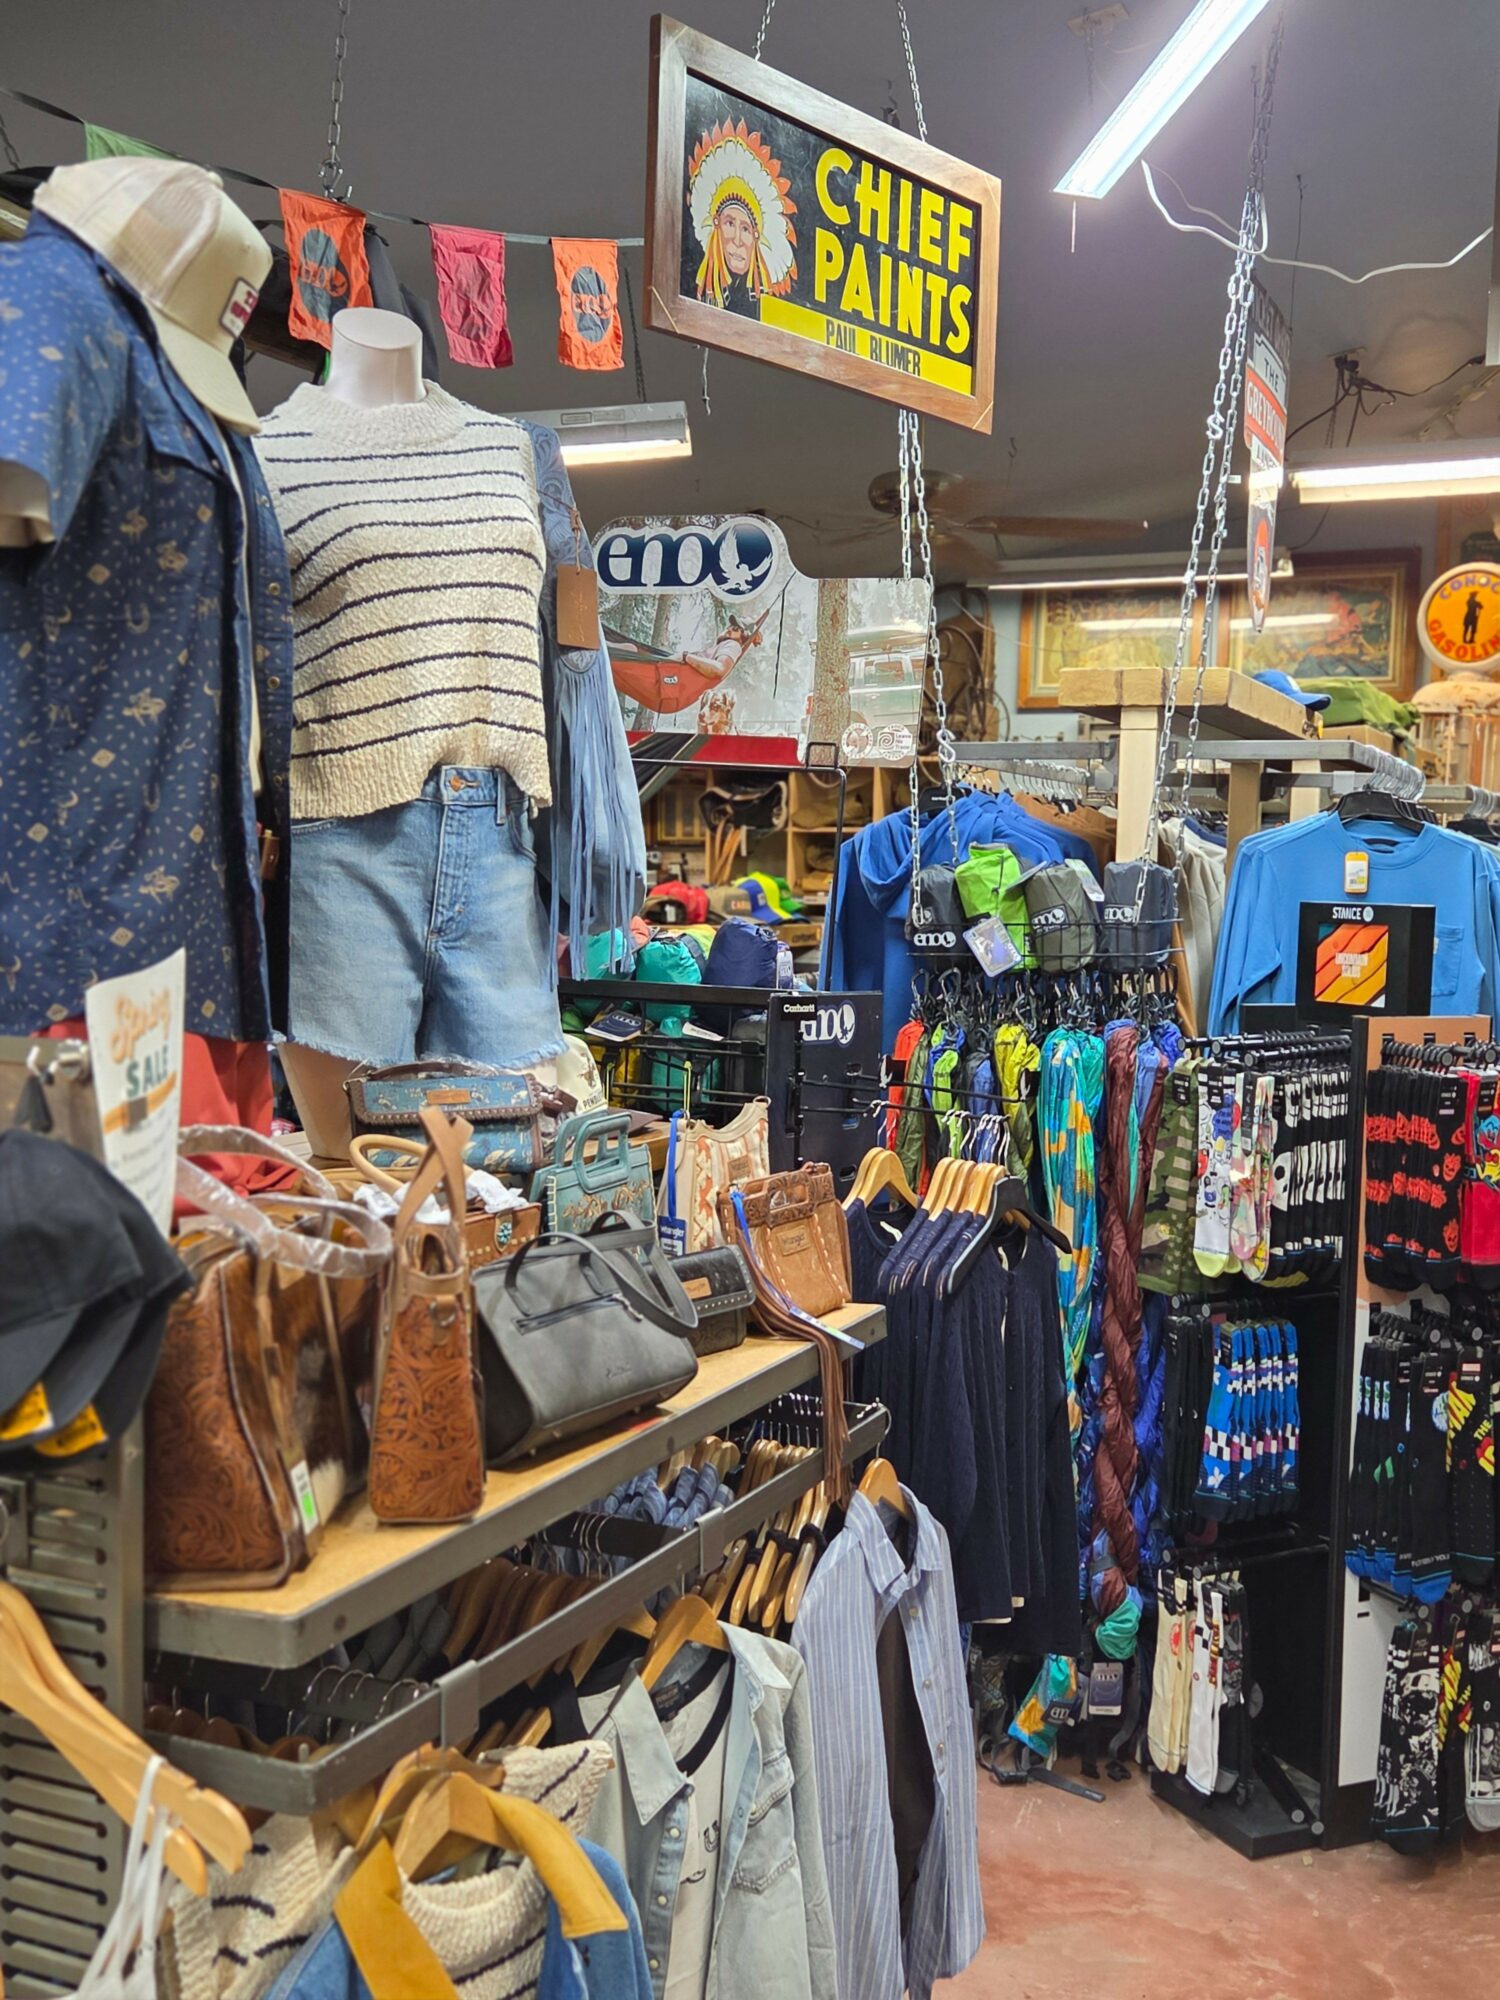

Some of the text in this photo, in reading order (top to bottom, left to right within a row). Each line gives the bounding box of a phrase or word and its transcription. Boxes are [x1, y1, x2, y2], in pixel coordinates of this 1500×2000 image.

[815, 147, 973, 274] CHIEF
[814, 227, 972, 354] PAINTS
[826, 319, 921, 377] PAUL BLUMER
[1264, 357, 1279, 393] THE
[1332, 906, 1362, 920] STANCE
[784, 1003, 816, 1013] Carhartt
[126, 1046, 169, 1098] SALE
[1473, 1418, 1492, 1440] THE
